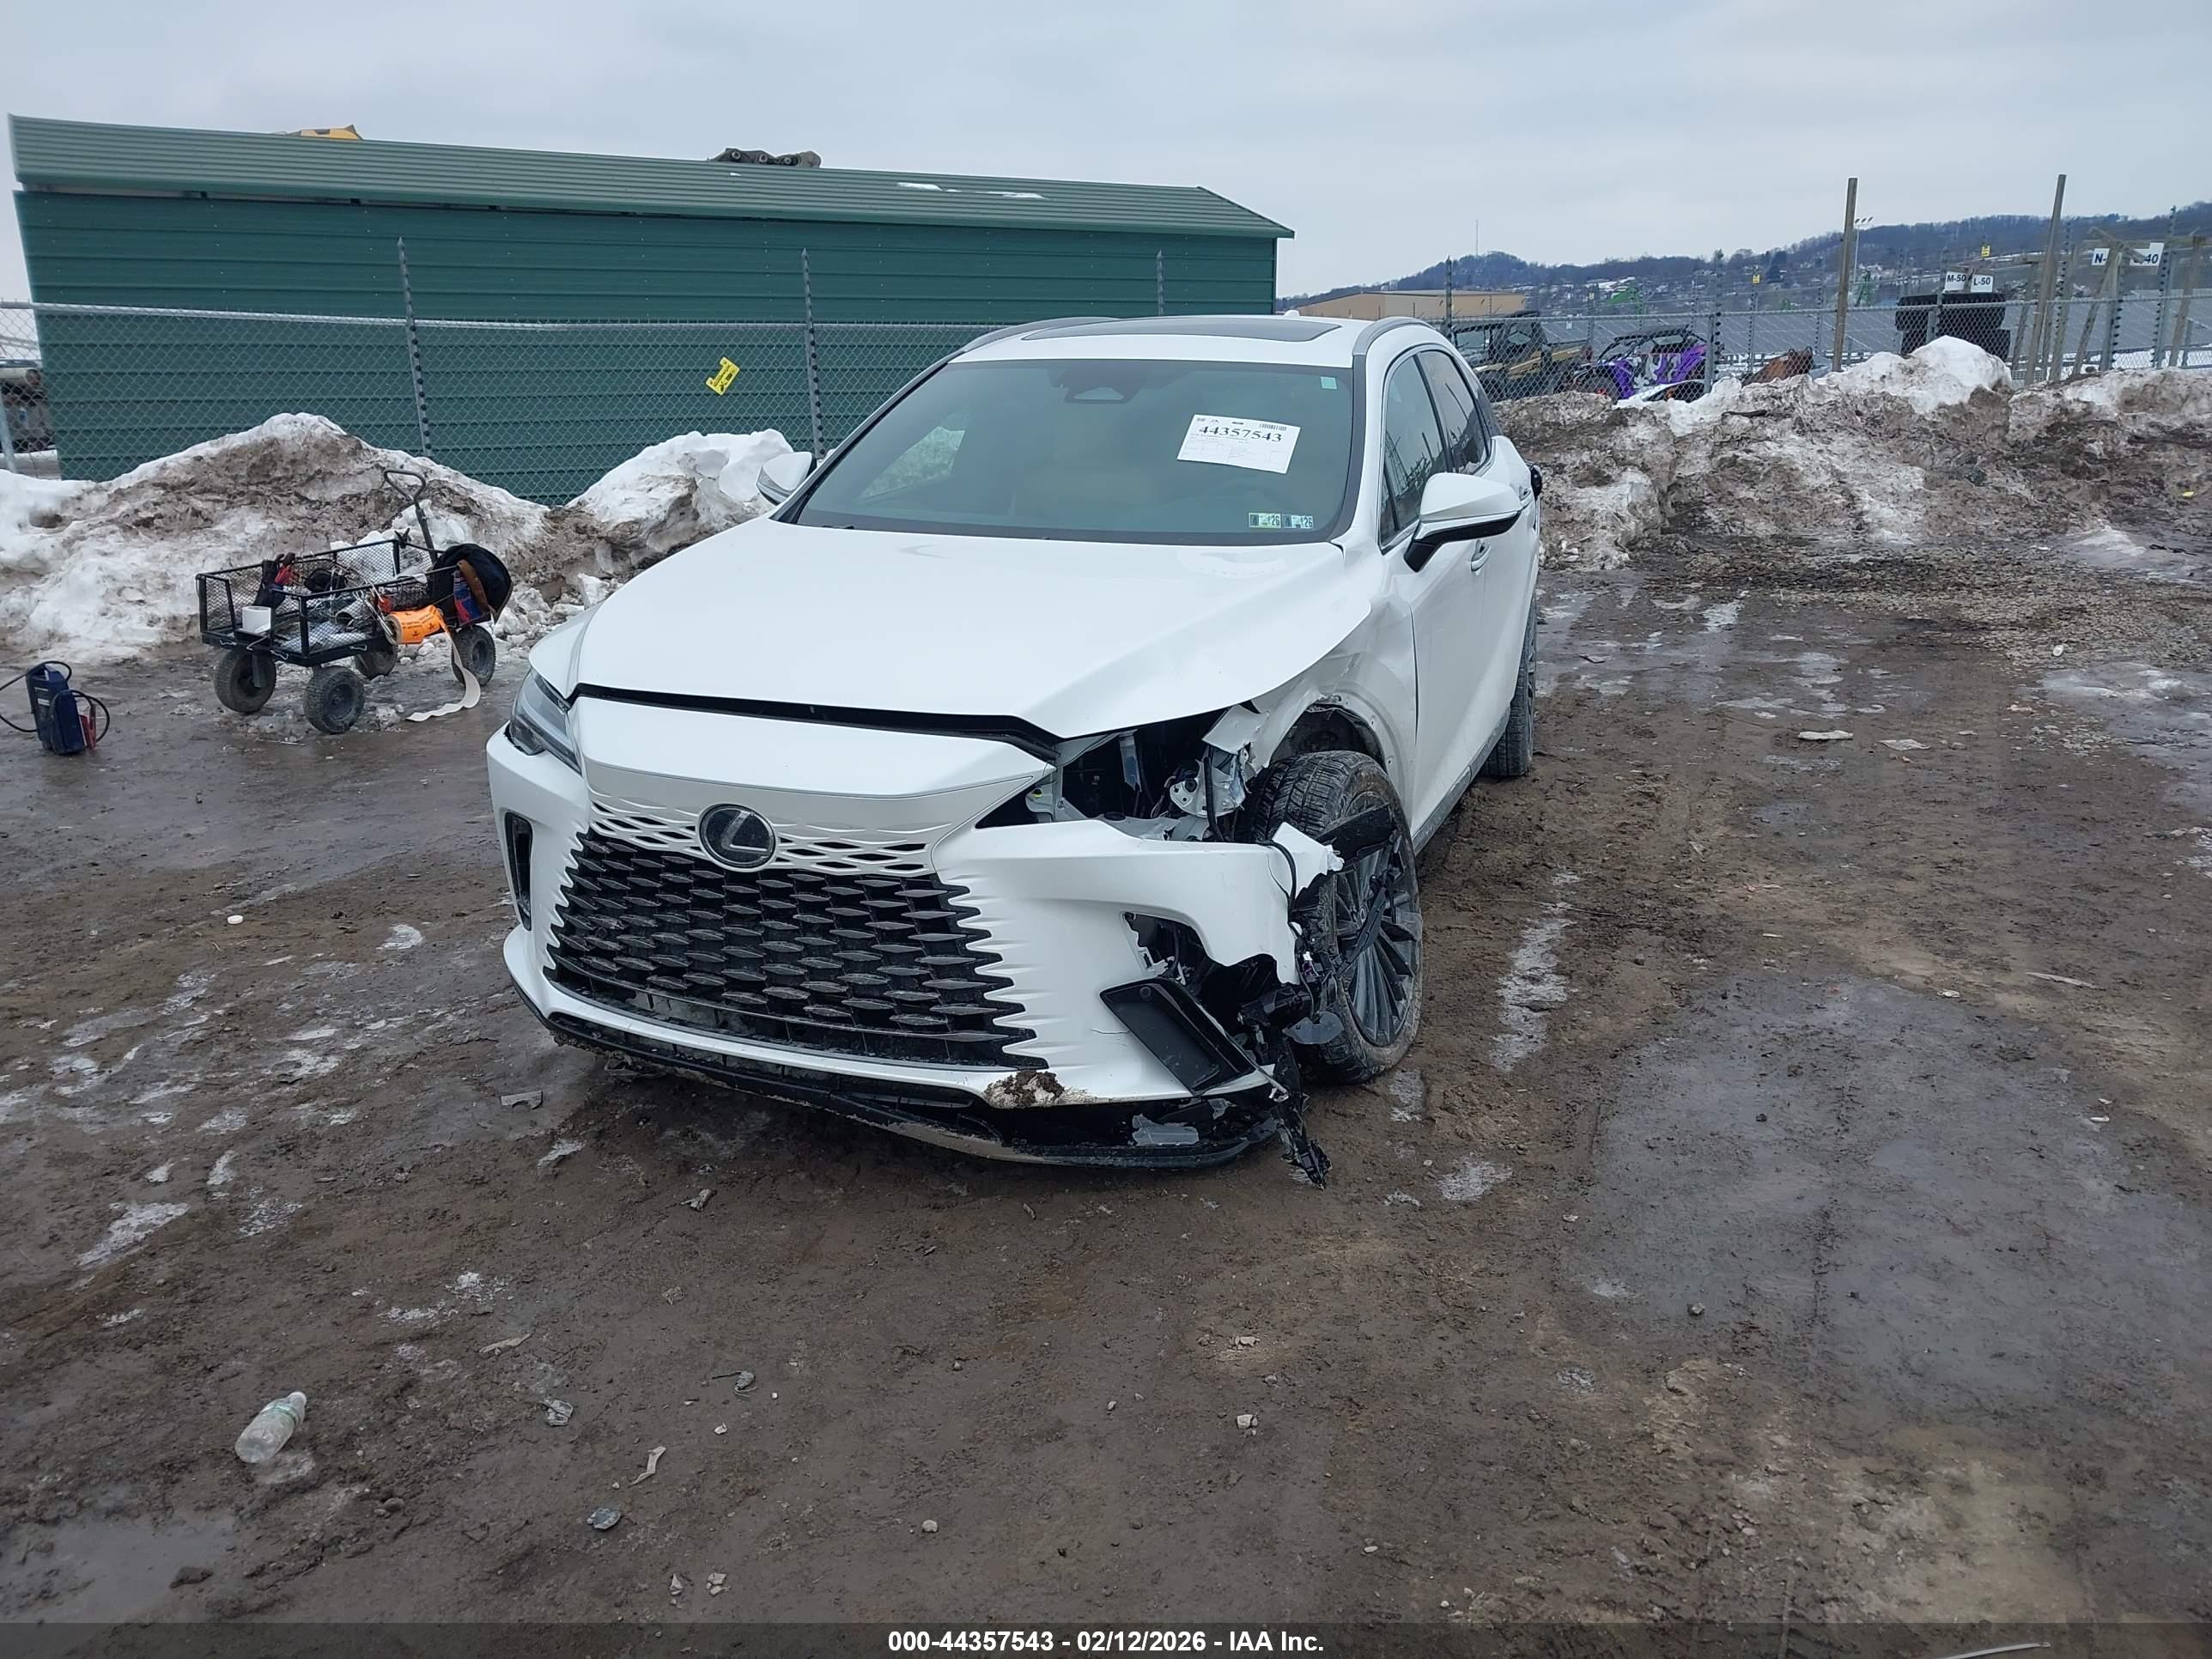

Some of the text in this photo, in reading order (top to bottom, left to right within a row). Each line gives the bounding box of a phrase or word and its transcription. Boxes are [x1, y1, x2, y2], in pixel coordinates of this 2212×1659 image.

[1973, 276, 1990, 286] L-50
[1199, 426, 1282, 442] 44357543
[1304, 517, 1313, 527] 26
